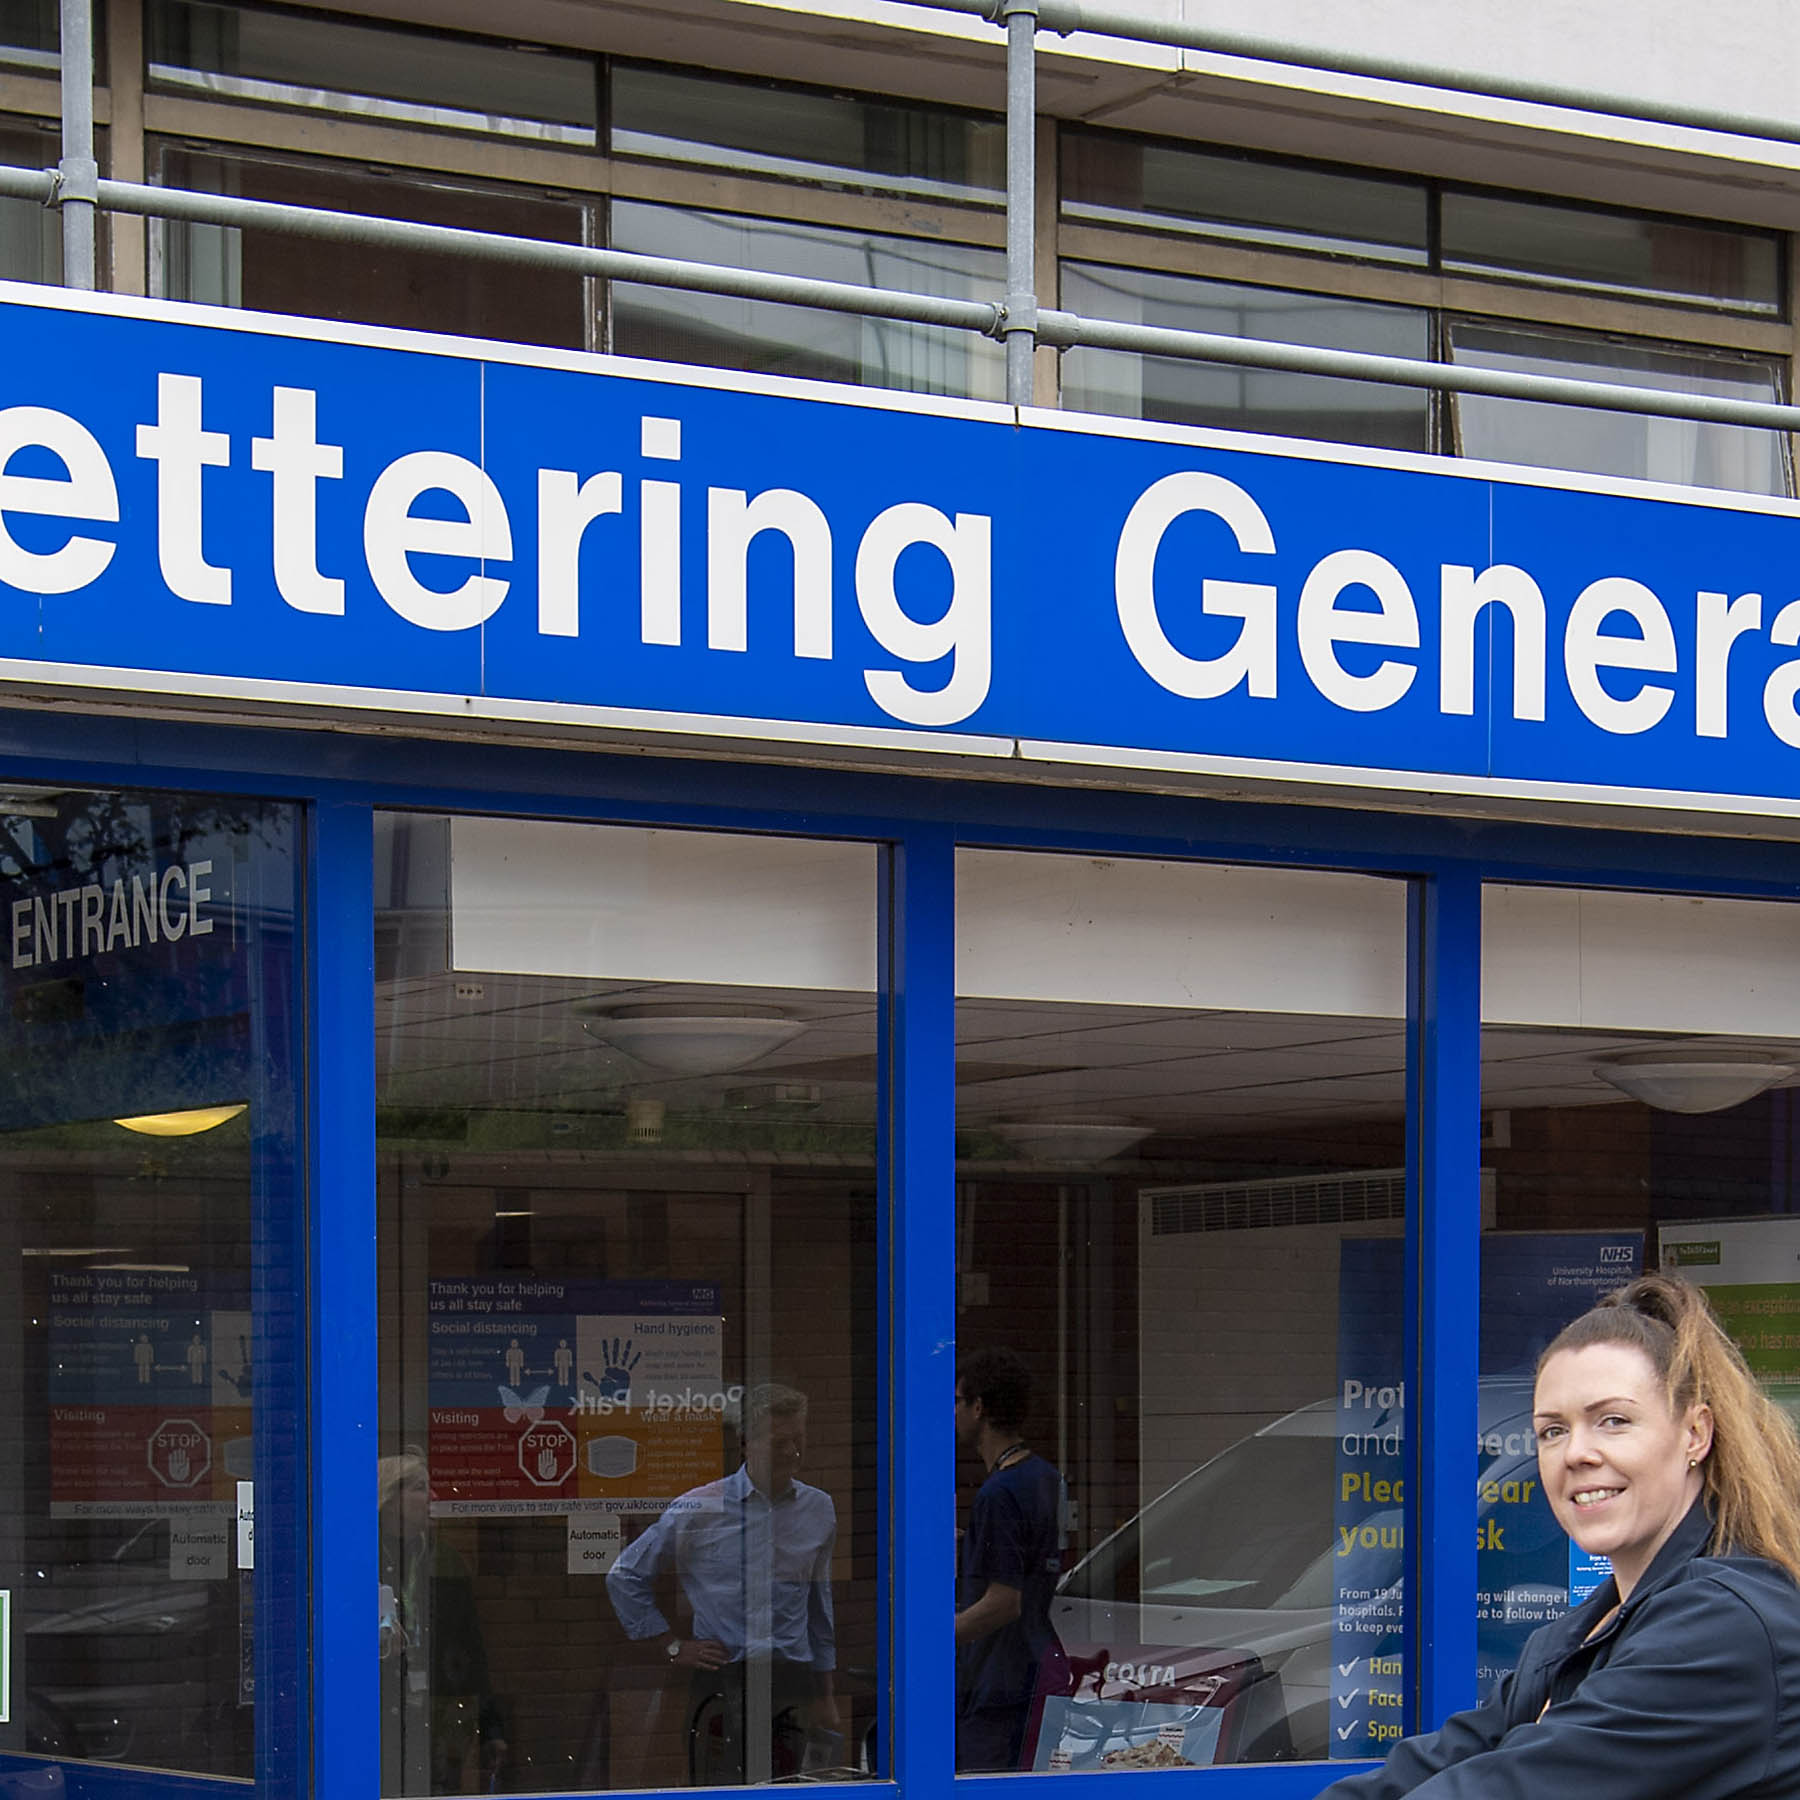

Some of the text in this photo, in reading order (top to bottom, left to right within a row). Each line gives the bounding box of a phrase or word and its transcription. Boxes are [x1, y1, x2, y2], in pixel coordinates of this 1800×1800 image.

[12, 860, 214, 969] ENTRANCE
[1602, 1246, 1633, 1262] NHS
[430, 1281, 565, 1298] Thank you for helping
[429, 1298, 522, 1313] us all stay safe
[431, 1321, 537, 1336] Social distancing
[634, 1322, 716, 1337] Hand hygiene
[431, 1411, 479, 1427] Visiting
[527, 1434, 568, 1448] STOP
[1342, 1432, 1401, 1456] and
[570, 1529, 620, 1540] Automatic
[582, 1549, 607, 1560] door
[1339, 1588, 1370, 1600] From
[1494, 1591, 1515, 1604] will
[1517, 1591, 1561, 1607] change
[1339, 1603, 1396, 1618] hospitals.
[1491, 1607, 1543, 1621] to follow
[1339, 1621, 1383, 1636] to keep
[1103, 1661, 1176, 1688] COSTA
